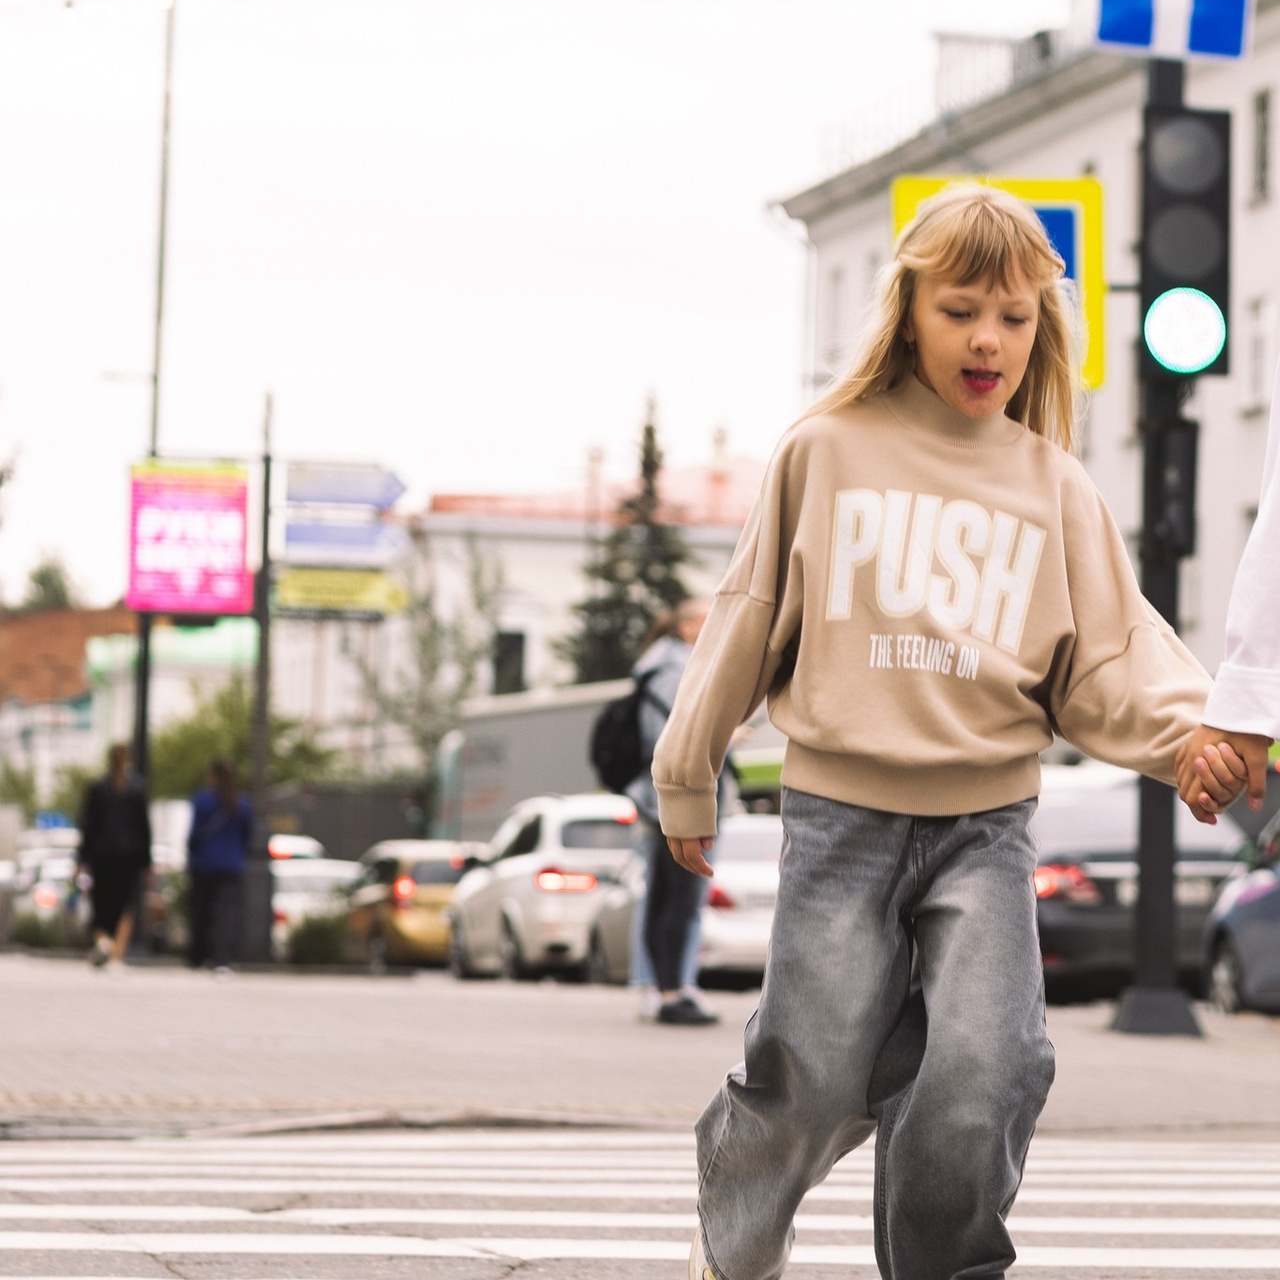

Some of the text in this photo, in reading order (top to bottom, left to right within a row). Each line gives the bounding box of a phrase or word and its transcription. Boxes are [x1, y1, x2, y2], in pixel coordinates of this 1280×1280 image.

[825, 487, 1047, 657] PUSH
[869, 633, 980, 681] THE FEELING ON
